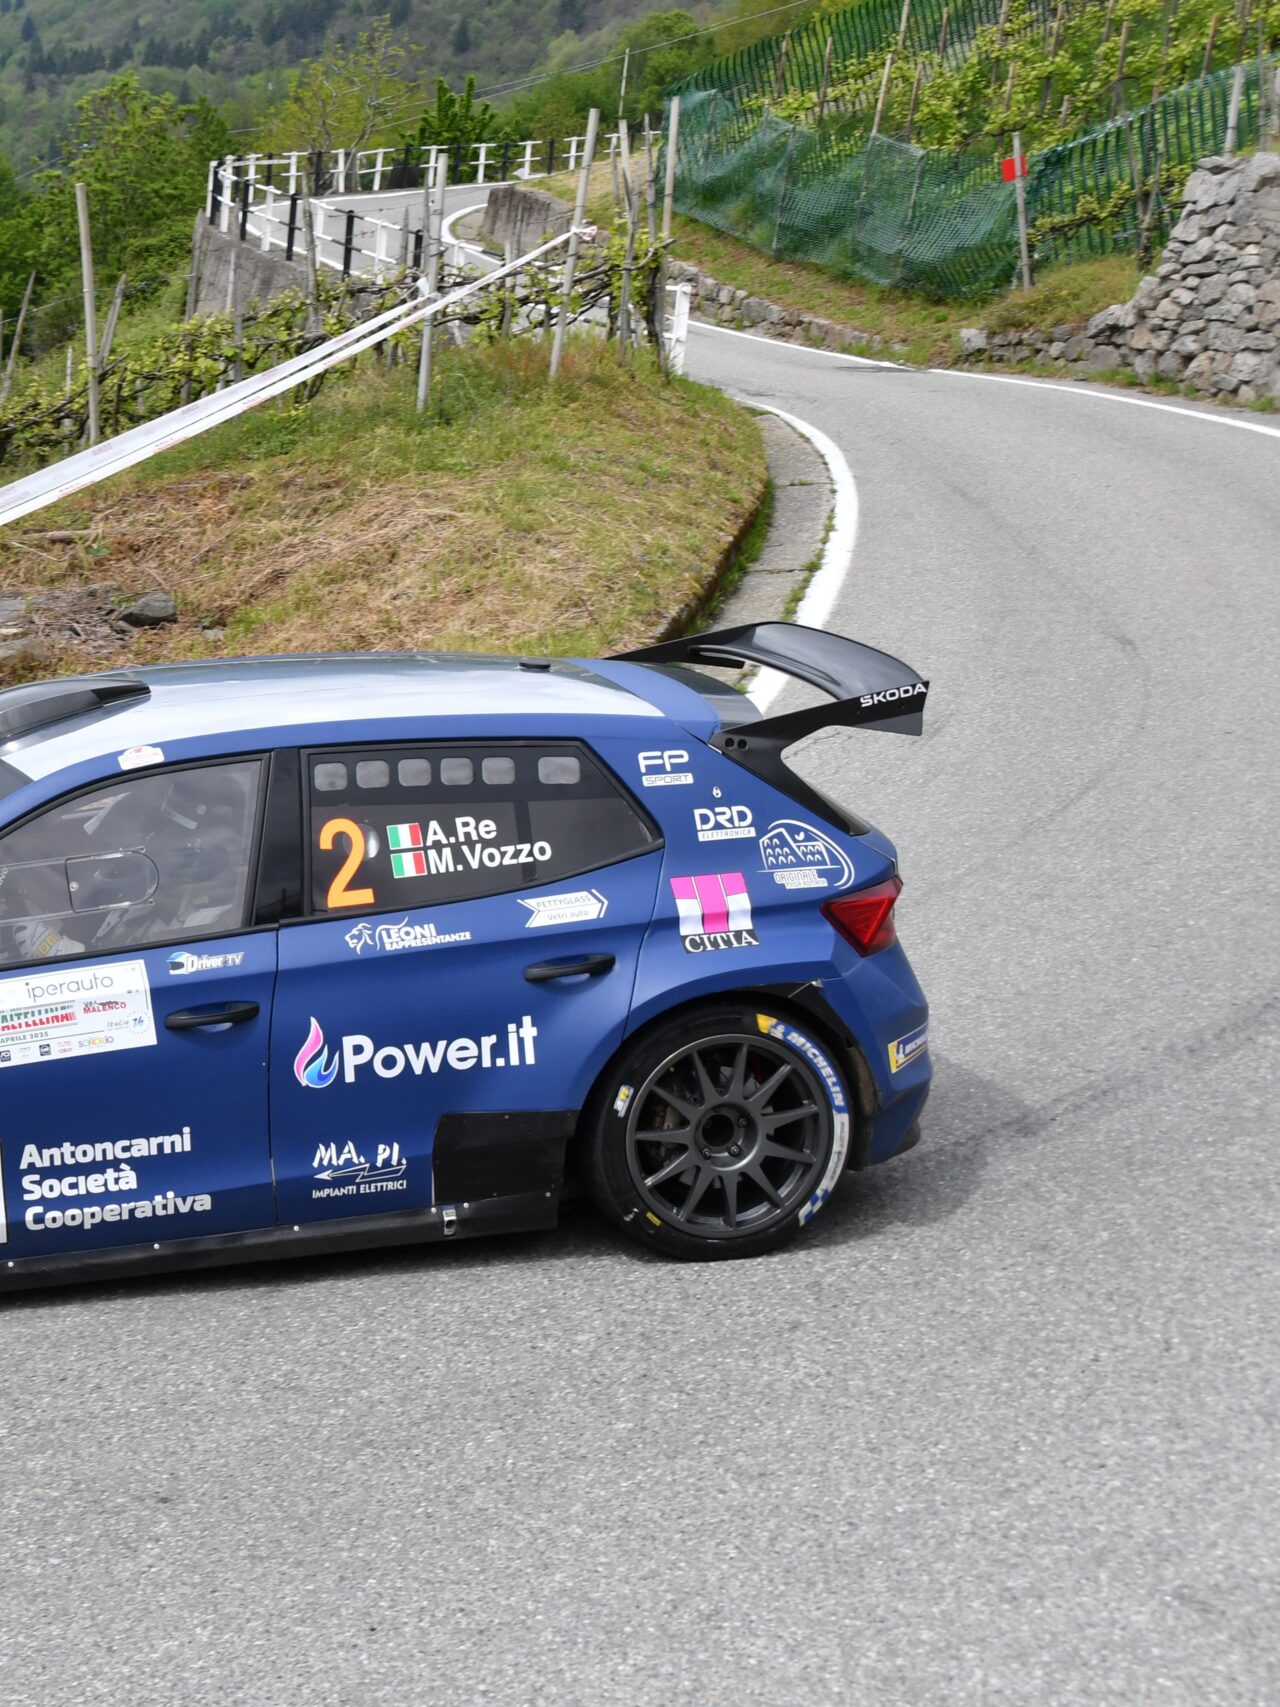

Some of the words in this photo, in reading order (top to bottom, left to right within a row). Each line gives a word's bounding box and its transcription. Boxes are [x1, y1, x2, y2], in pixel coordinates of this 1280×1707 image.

[637, 750, 689, 774] FP
[644, 774, 690, 785] SPORT
[693, 805, 753, 831] DRD
[425, 816, 498, 847] A.Re
[319, 818, 375, 908] 2
[427, 841, 552, 874] M.Vozzo
[536, 895, 591, 908] PETTYGLASS
[381, 923, 437, 944] LEONI
[385, 931, 472, 951] RAPPRESENTANZE
[684, 930, 760, 953] CITIA
[187, 955, 224, 973] Driver
[25, 973, 113, 1003] iperauto
[83, 1001, 127, 1015] MALENCO
[0, 1035, 27, 1044] APRILE
[341, 1015, 538, 1083] Power.it
[787, 1031, 845, 1107] MICHELIN
[20, 1127, 191, 1169] Antoncarni
[312, 1140, 365, 1168] MA.
[376, 1141, 407, 1168] PI.
[21, 1163, 138, 1201] Società
[312, 1185, 357, 1199] IMPIANTI
[360, 1179, 407, 1194] ELETTRICI
[24, 1191, 212, 1231] Cooperativa
